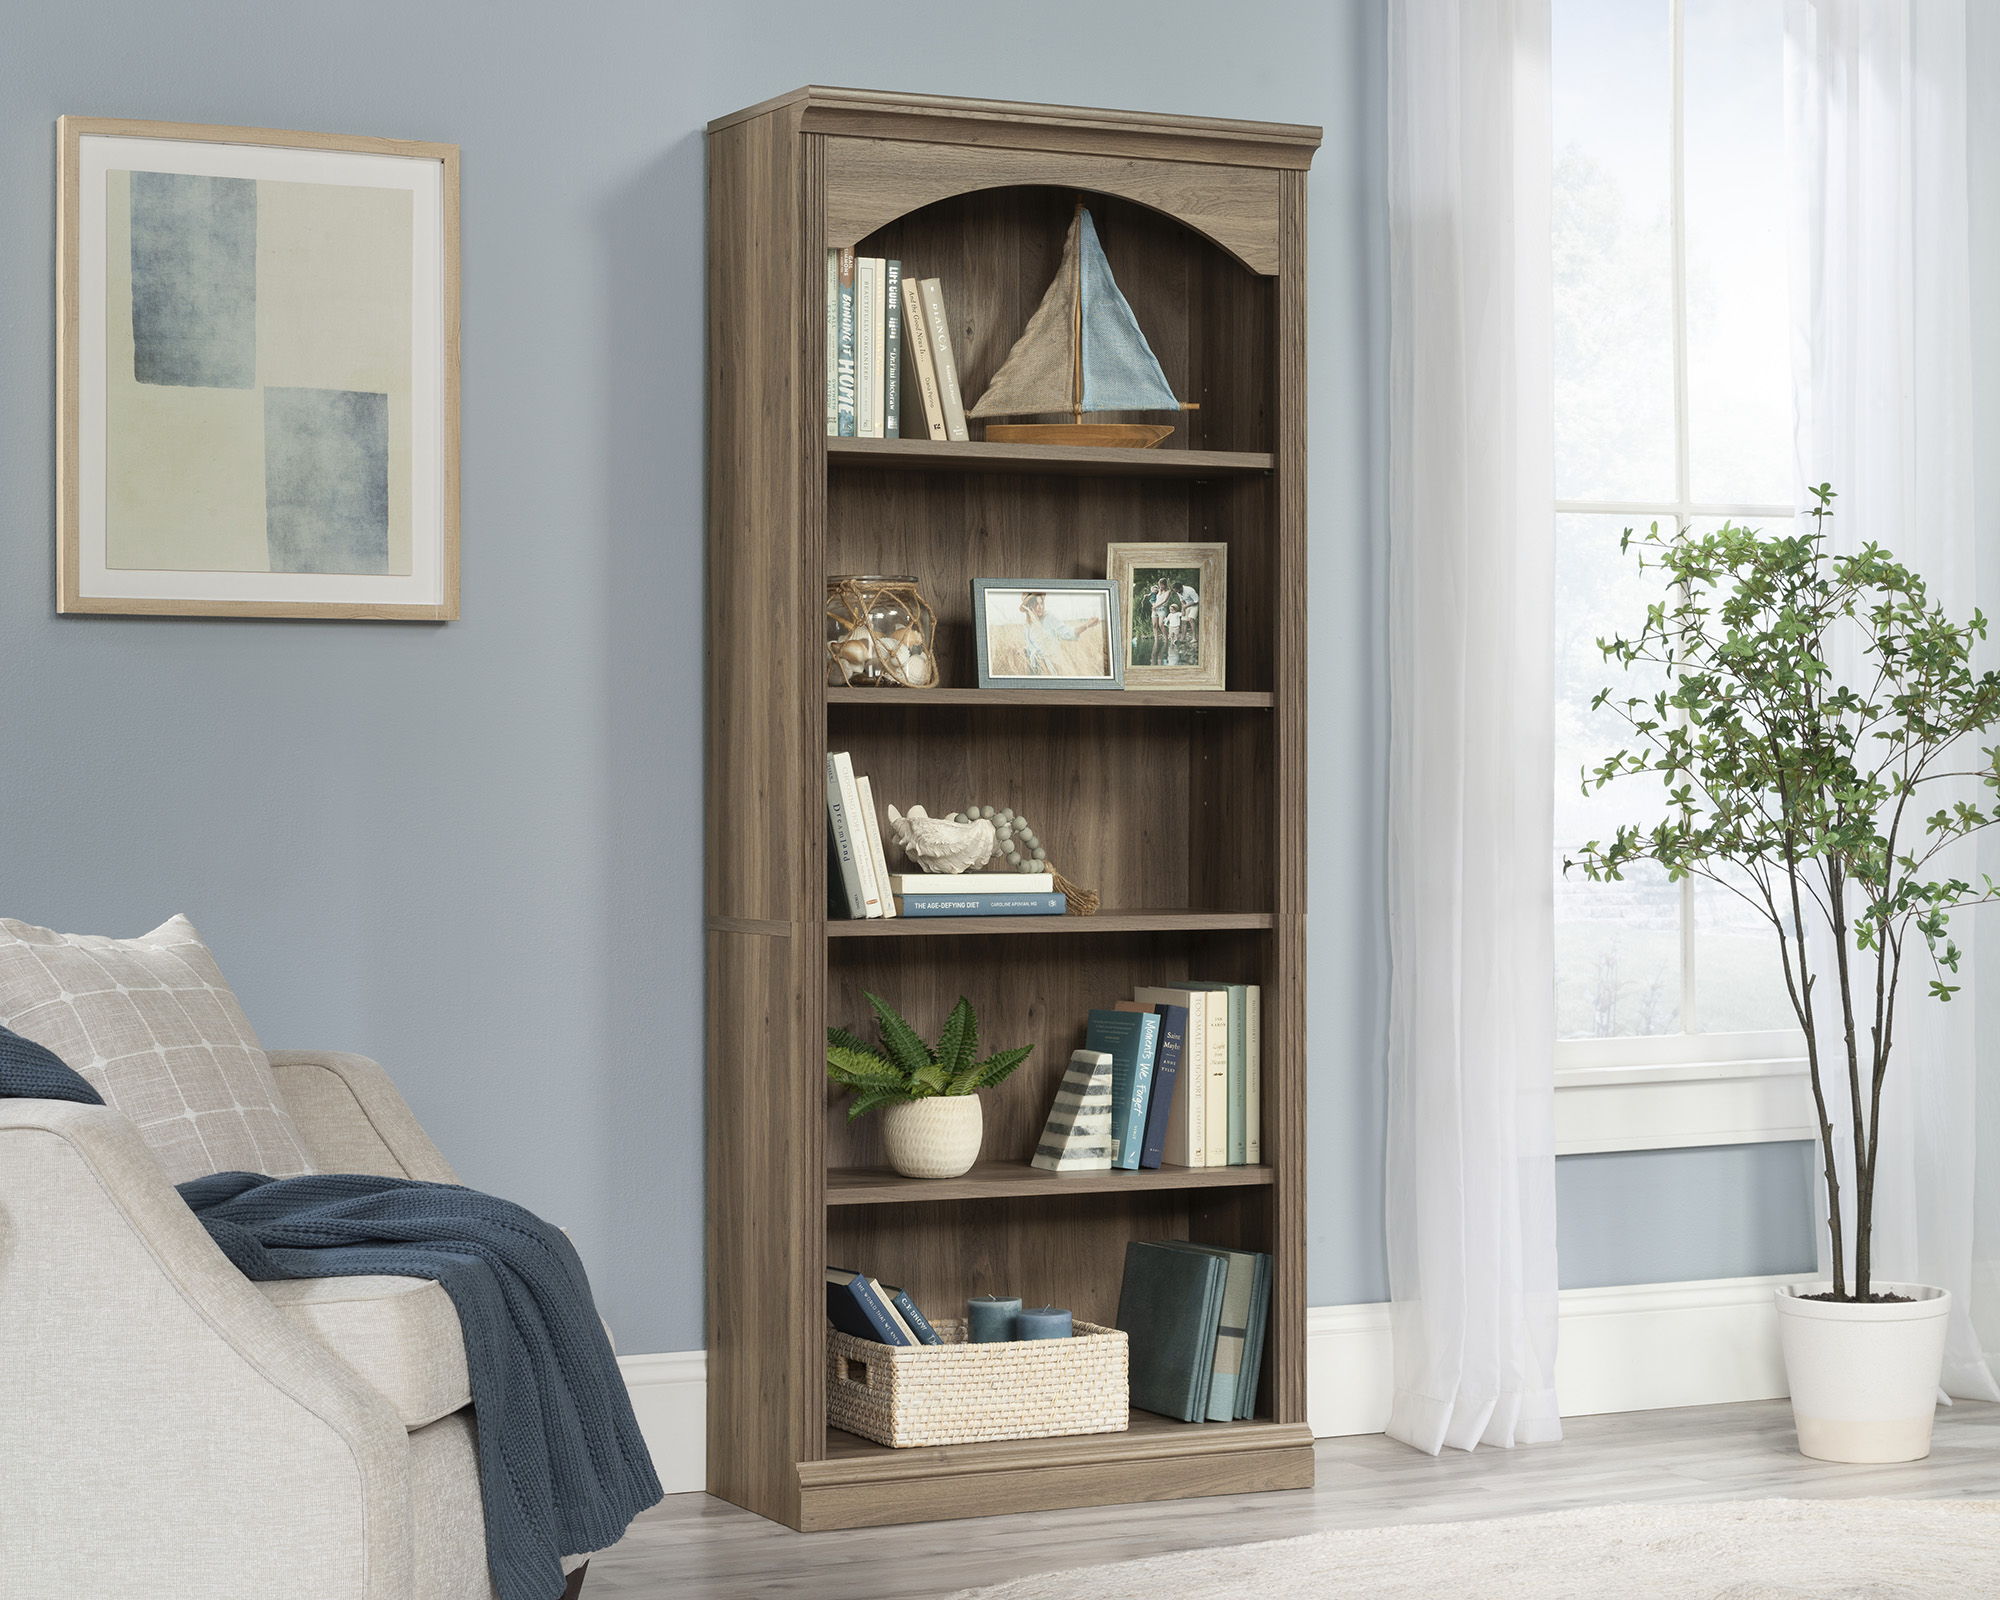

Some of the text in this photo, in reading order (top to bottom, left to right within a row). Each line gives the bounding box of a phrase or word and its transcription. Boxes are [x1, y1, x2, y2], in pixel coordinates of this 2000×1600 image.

[932, 303, 948, 352] BIANCA
[838, 293, 854, 416] BRINGING IT HOME
[914, 901, 980, 910] THE AGE-DEFYING DIET
[1142, 1020, 1157, 1060] Moments
[1166, 1031, 1181, 1041] Saint
[1194, 999, 1202, 1098] TOO SMALL TO IGNORE
[1140, 1063, 1151, 1080] We
[1131, 1084, 1147, 1117] Forget
[864, 1292, 877, 1311] WORLD
